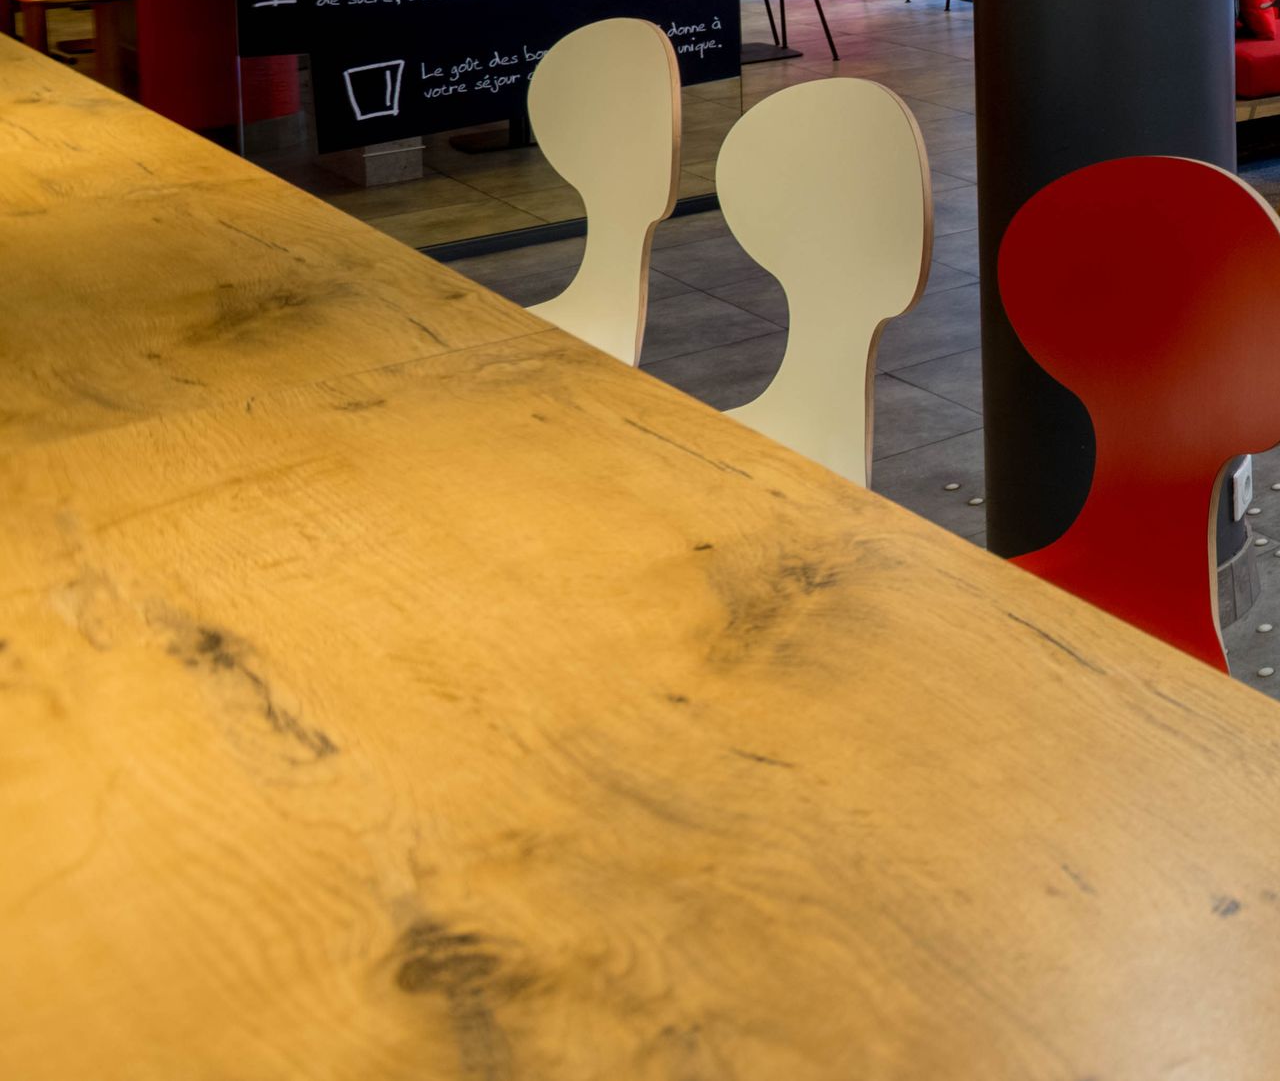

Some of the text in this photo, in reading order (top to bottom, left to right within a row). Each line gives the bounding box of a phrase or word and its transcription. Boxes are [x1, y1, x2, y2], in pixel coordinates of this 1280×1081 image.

[421, 61, 444, 80] Le
[450, 58, 483, 81] goût
[489, 52, 518, 67] des
[667, 21, 706, 37] donne
[712, 17, 721, 31] à
[424, 82, 467, 99] votre
[474, 73, 520, 93] séjour
[678, 37, 723, 58] unique.
